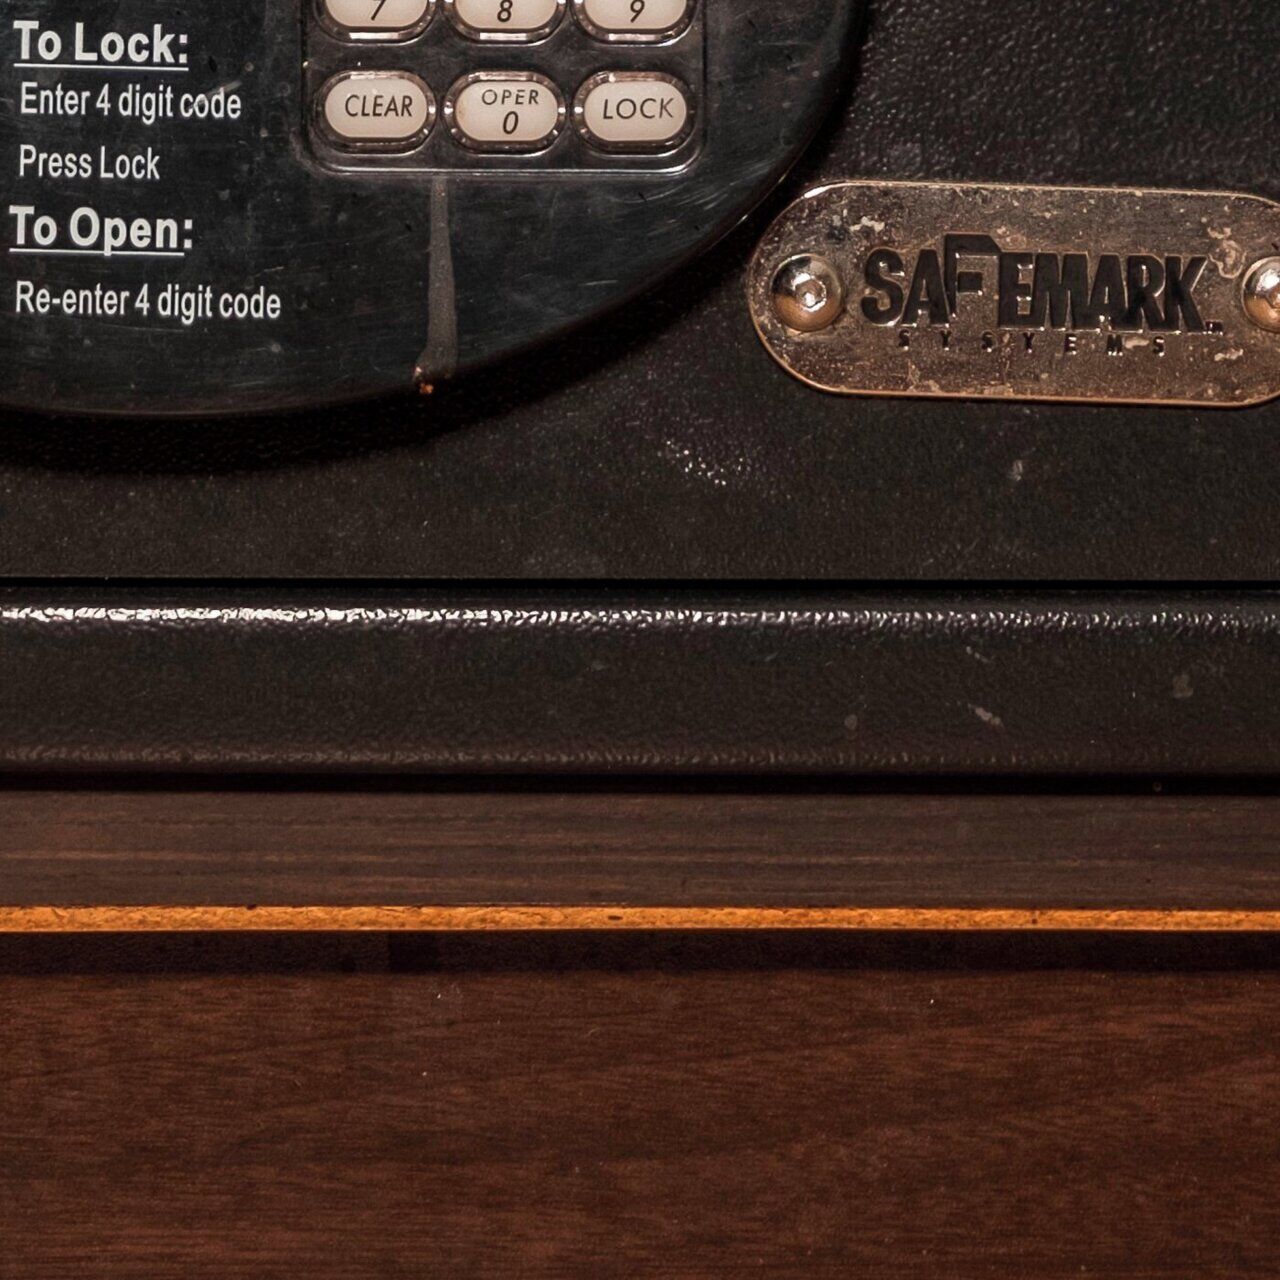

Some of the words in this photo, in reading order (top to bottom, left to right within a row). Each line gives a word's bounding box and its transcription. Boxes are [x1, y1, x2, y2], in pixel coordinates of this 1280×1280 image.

[497, 0, 513, 22] 8
[629, 0, 645, 23] 9
[13, 20, 62, 60] To
[75, 22, 188, 63] Lock:
[20, 82, 90, 115] Enter
[96, 83, 111, 116] 4
[118, 84, 173, 125] digit
[180, 87, 241, 118] code
[345, 94, 413, 117] CLEAR
[481, 89, 539, 105] OPER
[602, 97, 674, 119] LOCK
[503, 111, 518, 135] 0
[20, 144, 92, 178] Press
[100, 146, 160, 179] Lock
[9, 205, 57, 246] To
[70, 207, 192, 256] Open:
[861, 233, 1208, 333] SAFEMARK
[16, 280, 130, 315] Re-enter
[135, 283, 150, 315] 4
[157, 284, 213, 324] digit
[219, 286, 281, 318] code
